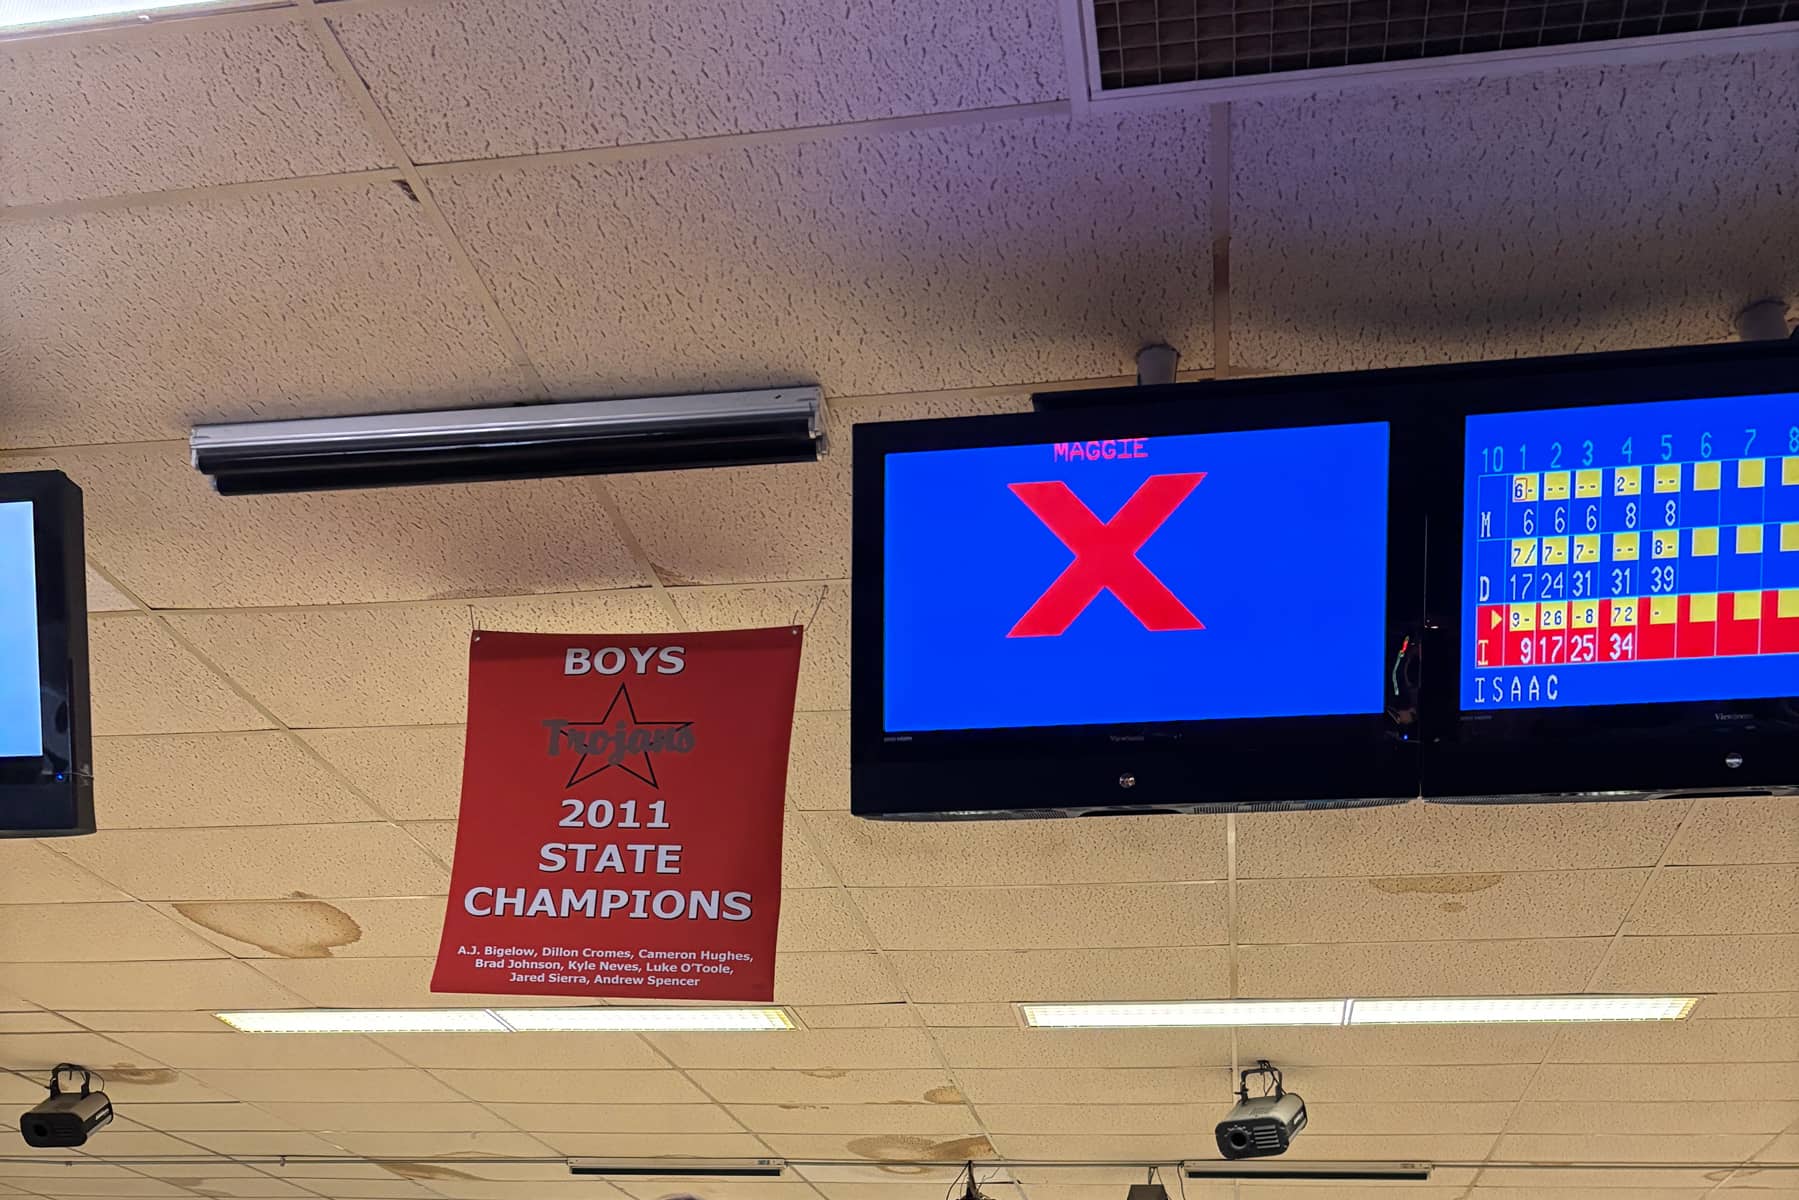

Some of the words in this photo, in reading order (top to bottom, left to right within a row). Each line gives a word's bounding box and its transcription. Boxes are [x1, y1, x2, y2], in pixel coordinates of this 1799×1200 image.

[1054, 437, 1149, 463] MAGGIE
[1483, 446, 1504, 473] 10
[1520, 444, 1527, 470] 1
[1551, 442, 1562, 468] 2
[1582, 440, 1594, 466] 3
[1621, 436, 1632, 464] 4
[1661, 434, 1673, 461] 5
[1701, 431, 1712, 458] 6
[1744, 428, 1757, 456] 7
[1789, 426, 1799, 453] 8
[1480, 511, 1492, 538] M
[1523, 508, 1534, 535] 6
[1554, 507, 1566, 533] 6
[1586, 504, 1597, 531] 6
[1625, 502, 1637, 529] 8
[1665, 500, 1676, 526] 8
[1007, 471, 1208, 638] X
[1479, 576, 1490, 602] D
[1510, 574, 1533, 601] 17
[1541, 571, 1564, 599] 24
[1573, 570, 1591, 597] 31
[1611, 568, 1631, 595] 31
[1651, 565, 1675, 593] 39
[564, 646, 686, 676] BOYS
[1478, 639, 1489, 666] I
[1520, 637, 1532, 664] 9
[1540, 635, 1563, 663] 17
[1570, 634, 1594, 662] 25
[1609, 632, 1633, 660] 34
[1474, 674, 1559, 703] ISAAC
[542, 719, 697, 765] Trojans
[558, 799, 671, 830] 2011
[538, 842, 682, 874] STATE
[464, 886, 753, 921] CHAMPIONS
[457, 946, 480, 955] A.J.
[484, 946, 538, 958] Bigelow,
[542, 947, 579, 957] Dillon
[582, 948, 634, 959] Cromes,
[638, 949, 696, 960] Cameron
[700, 950, 754, 963] Hughes,
[475, 959, 505, 968] Brad
[508, 959, 564, 971] Johnson,
[568, 961, 596, 972] Kyle
[600, 962, 642, 972] Neves,
[646, 962, 677, 973] Luke
[681, 963, 734, 975] O'Toole,
[509, 972, 545, 983] Jared
[548, 974, 590, 985] Sierra,
[594, 974, 644, 985] Andrew
[647, 976, 700, 987] Spencer
